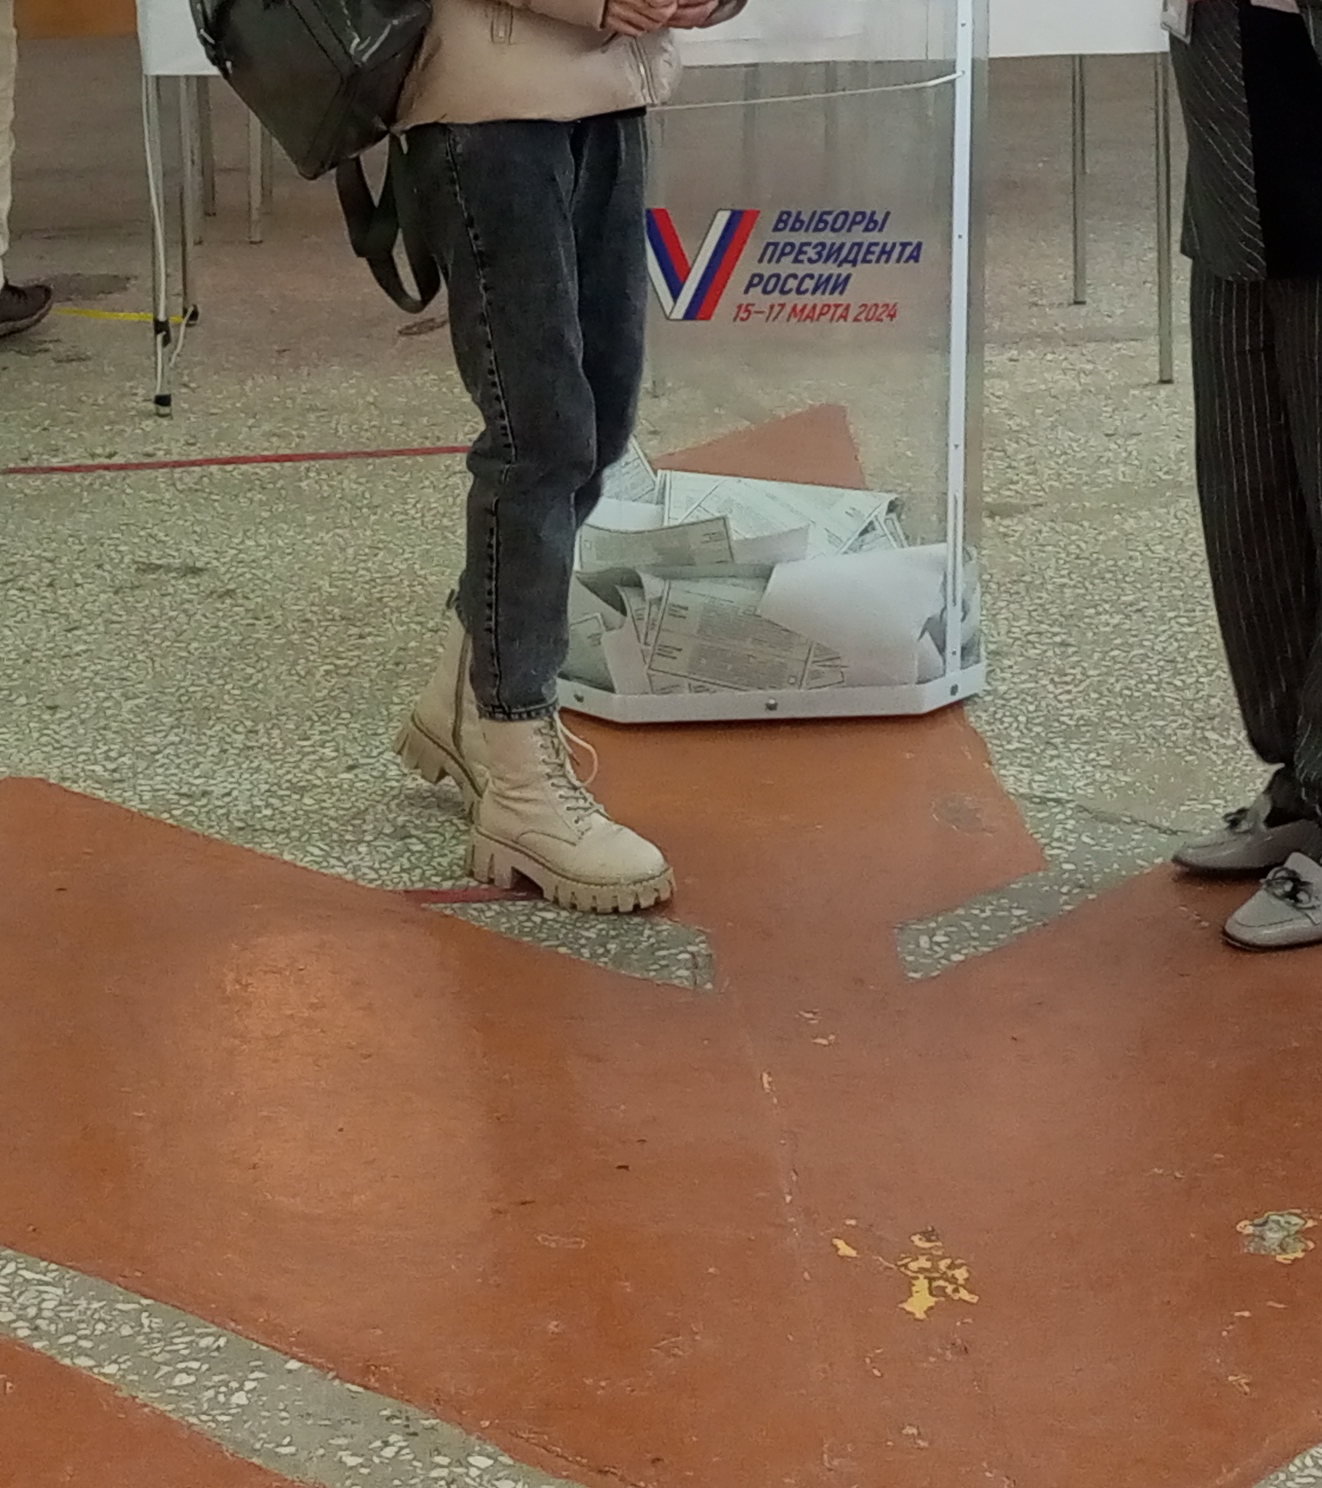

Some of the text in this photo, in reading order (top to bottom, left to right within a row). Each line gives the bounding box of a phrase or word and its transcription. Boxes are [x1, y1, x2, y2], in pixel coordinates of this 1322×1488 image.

[772, 210, 891, 233] ВЫБОРЫ
[758, 241, 923, 268] ПРЕЗИДЕНТА
[743, 273, 852, 295] РОССИИ
[733, 302, 899, 323] 15–17 МАРТА 2024
